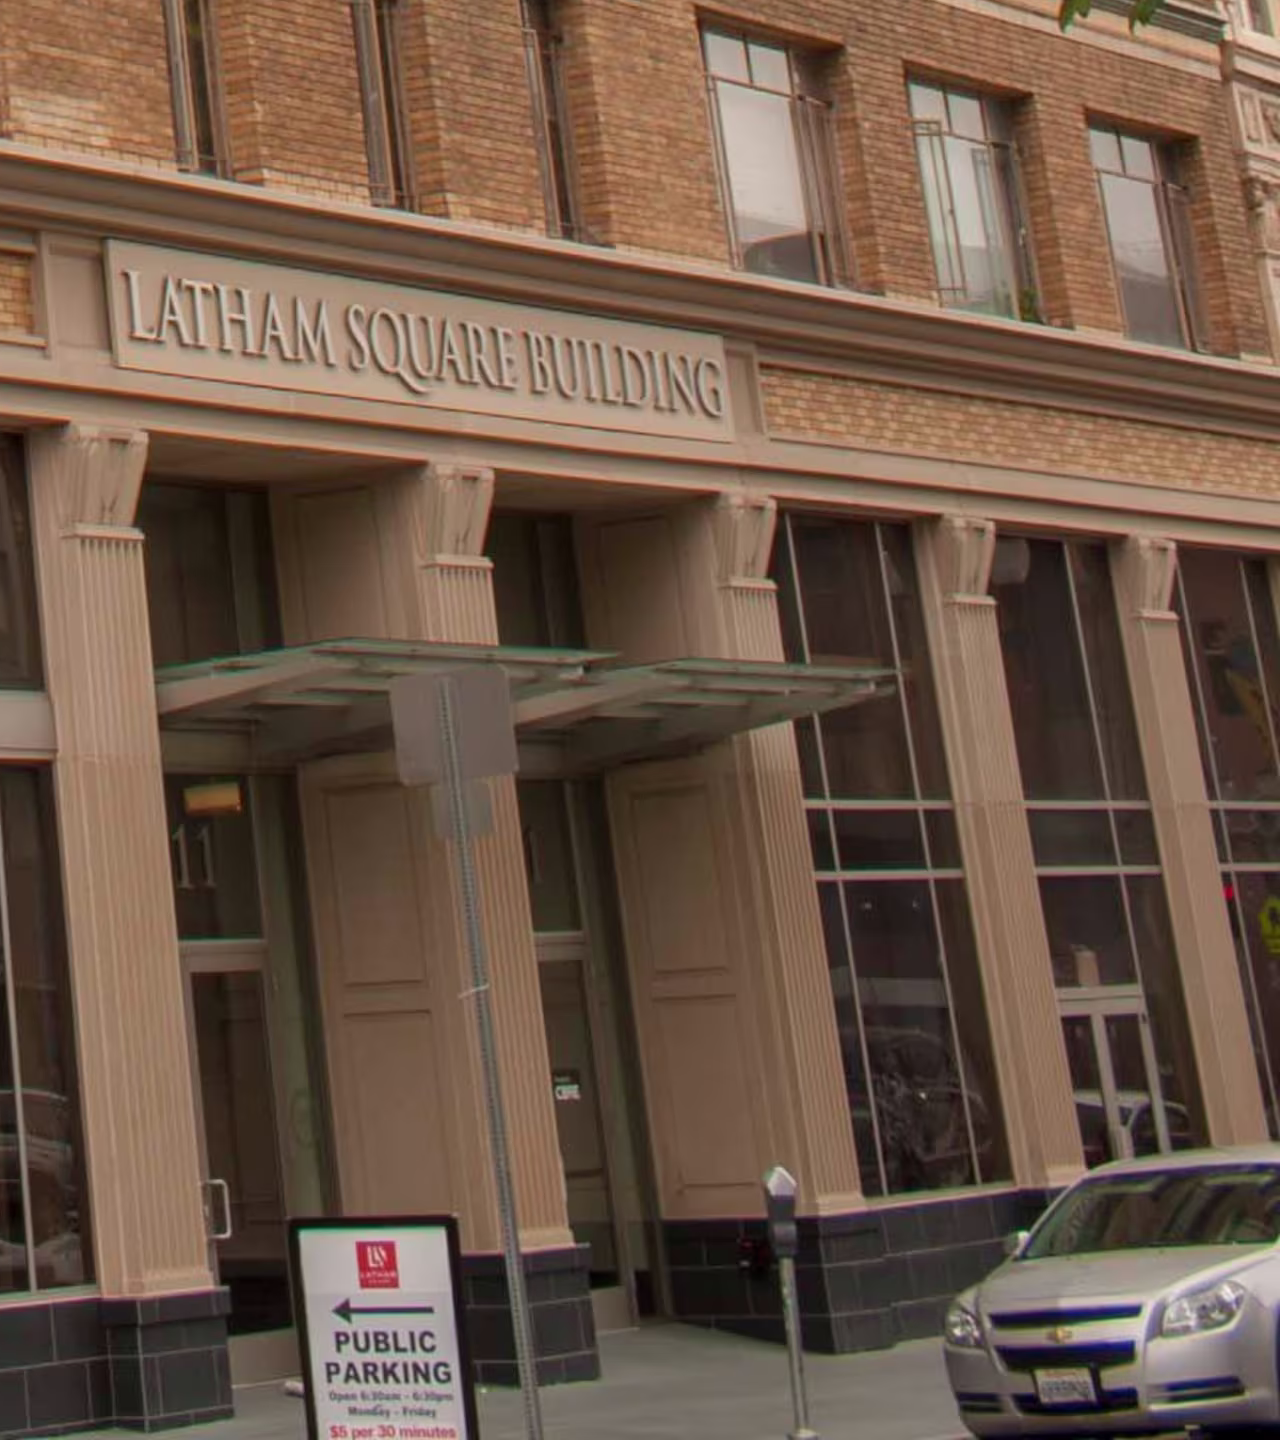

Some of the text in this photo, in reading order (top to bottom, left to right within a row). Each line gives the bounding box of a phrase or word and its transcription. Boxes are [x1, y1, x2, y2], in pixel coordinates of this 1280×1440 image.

[122, 269, 725, 418] LATHAM SQUARE BUILDING
[334, 1330, 436, 1353] PUBLIC
[325, 1362, 452, 1384] PARKING
[377, 1425, 395, 1439] 30
[399, 1426, 456, 1439] minutes
